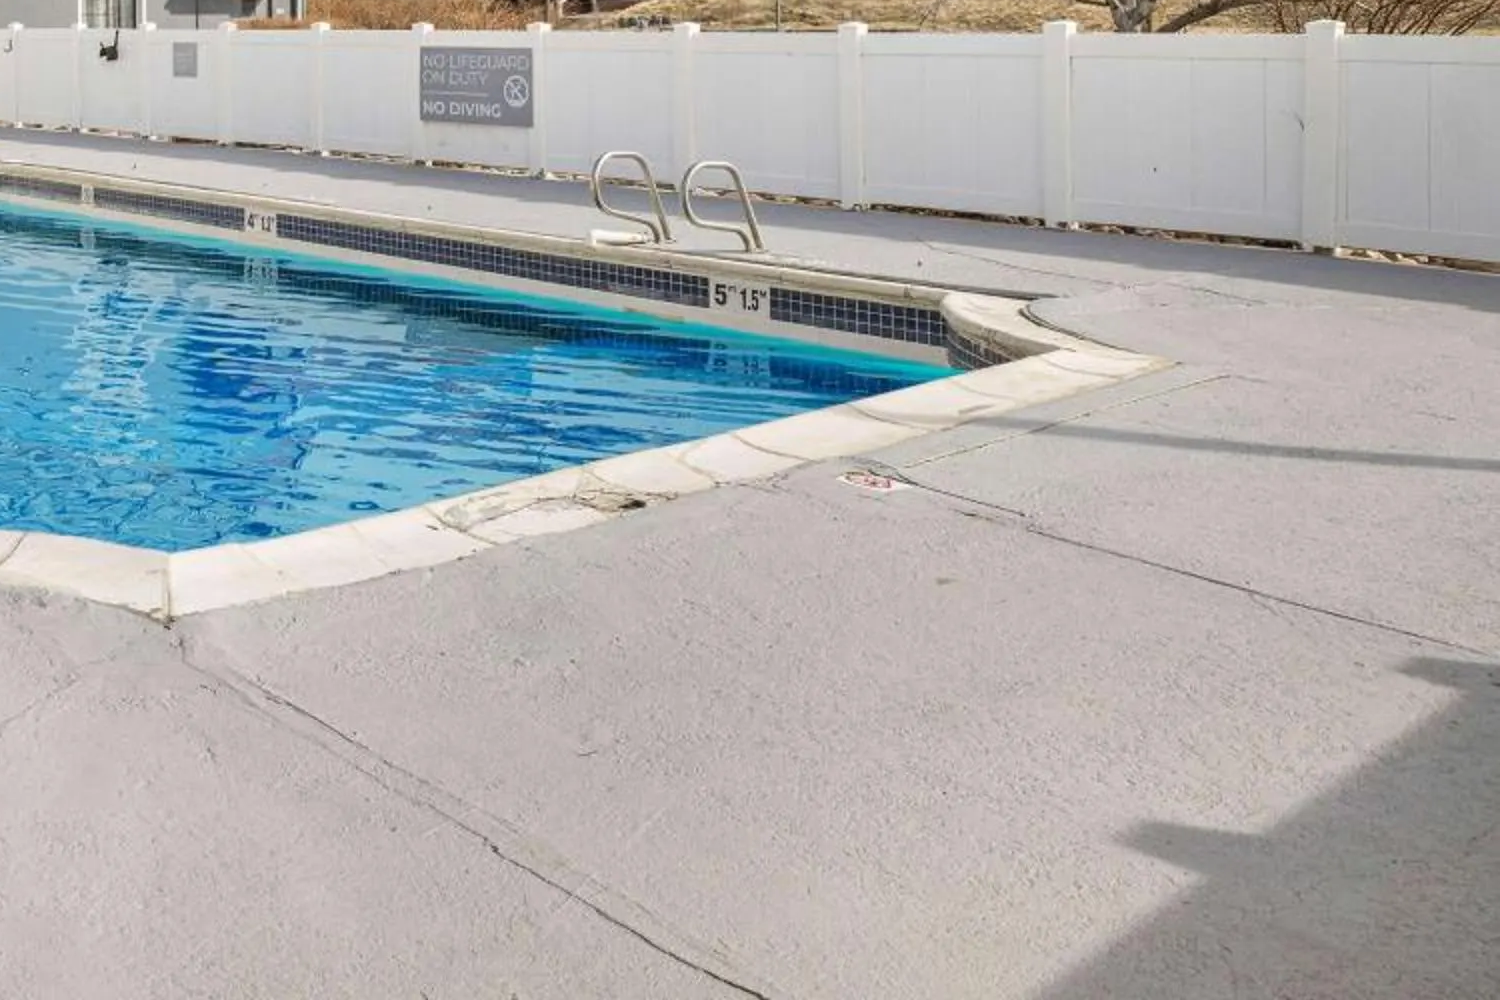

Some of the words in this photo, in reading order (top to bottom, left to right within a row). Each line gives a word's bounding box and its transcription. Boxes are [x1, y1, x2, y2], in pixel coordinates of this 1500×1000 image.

[423, 55, 445, 69] NO
[449, 55, 529, 71] LIFEGUARD
[422, 70, 445, 83] ON
[449, 71, 487, 86] DUTY
[424, 102, 445, 115] NO
[449, 103, 501, 118] DIVING
[714, 284, 727, 305] 5
